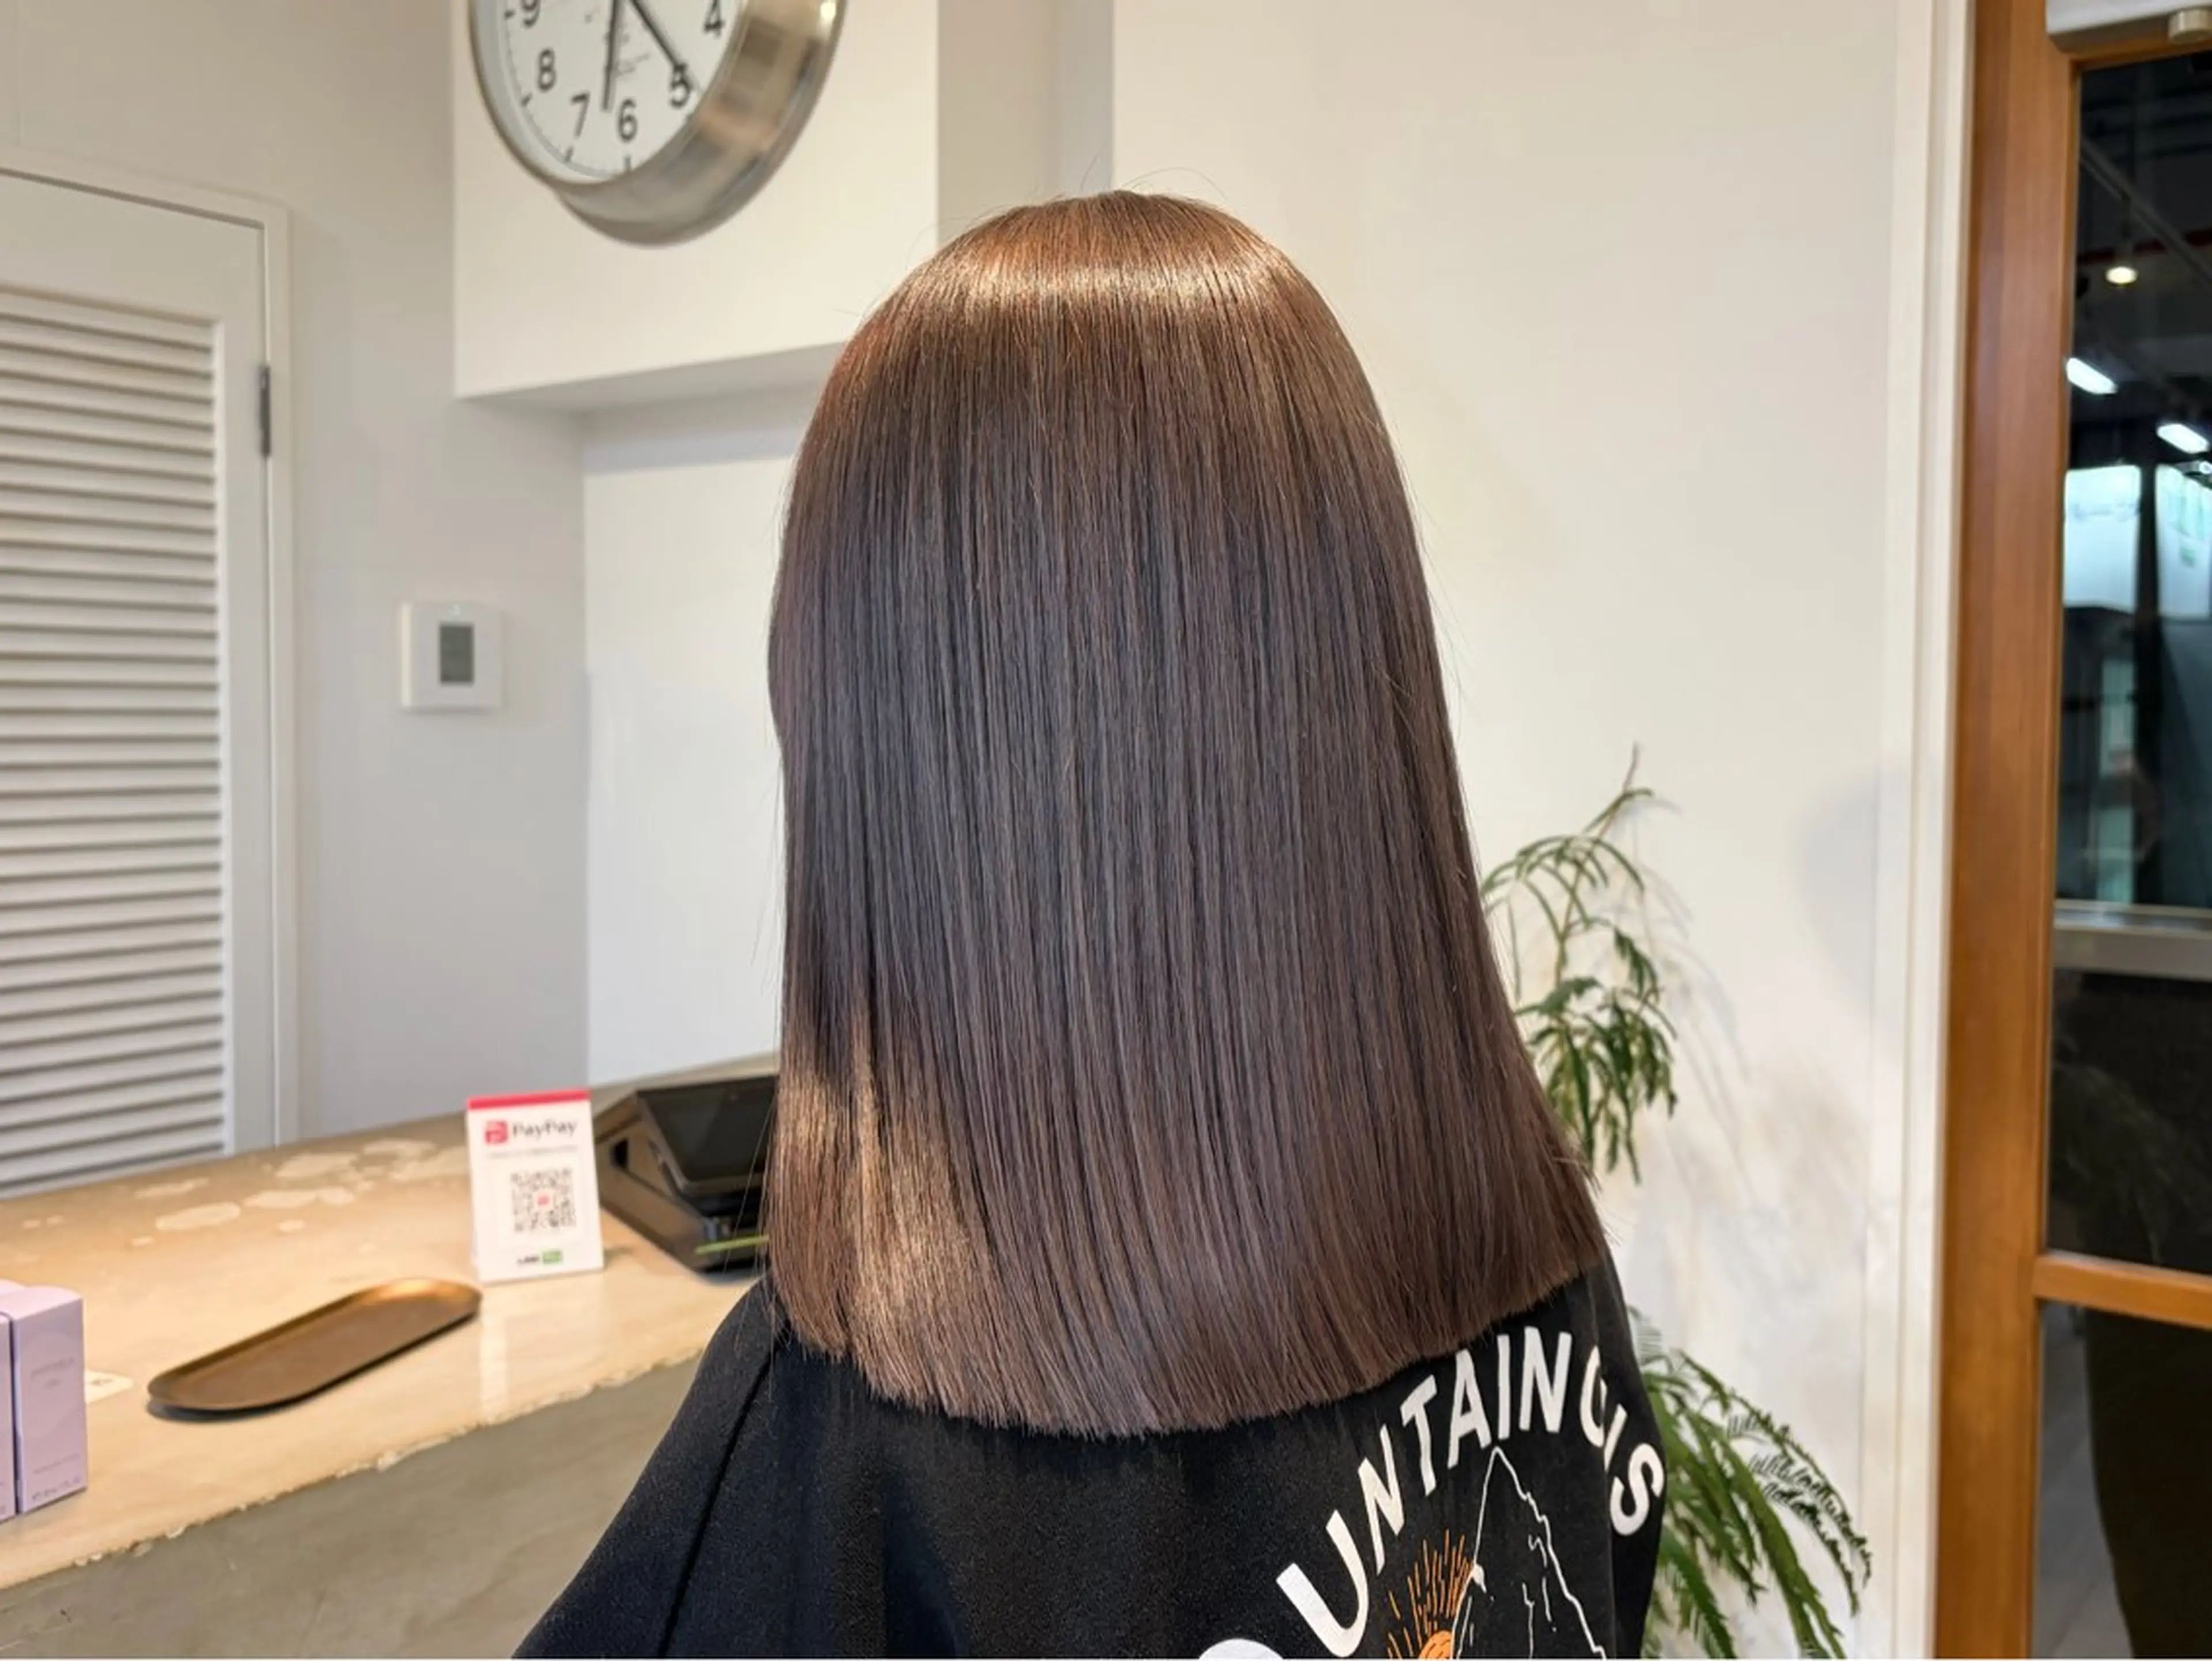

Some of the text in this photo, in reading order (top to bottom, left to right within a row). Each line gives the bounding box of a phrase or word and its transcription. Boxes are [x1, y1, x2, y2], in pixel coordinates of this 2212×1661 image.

[537, 48, 556, 91] 8
[571, 92, 590, 137] 7
[618, 99, 638, 142] 6
[512, 1117, 577, 1141] PayPay
